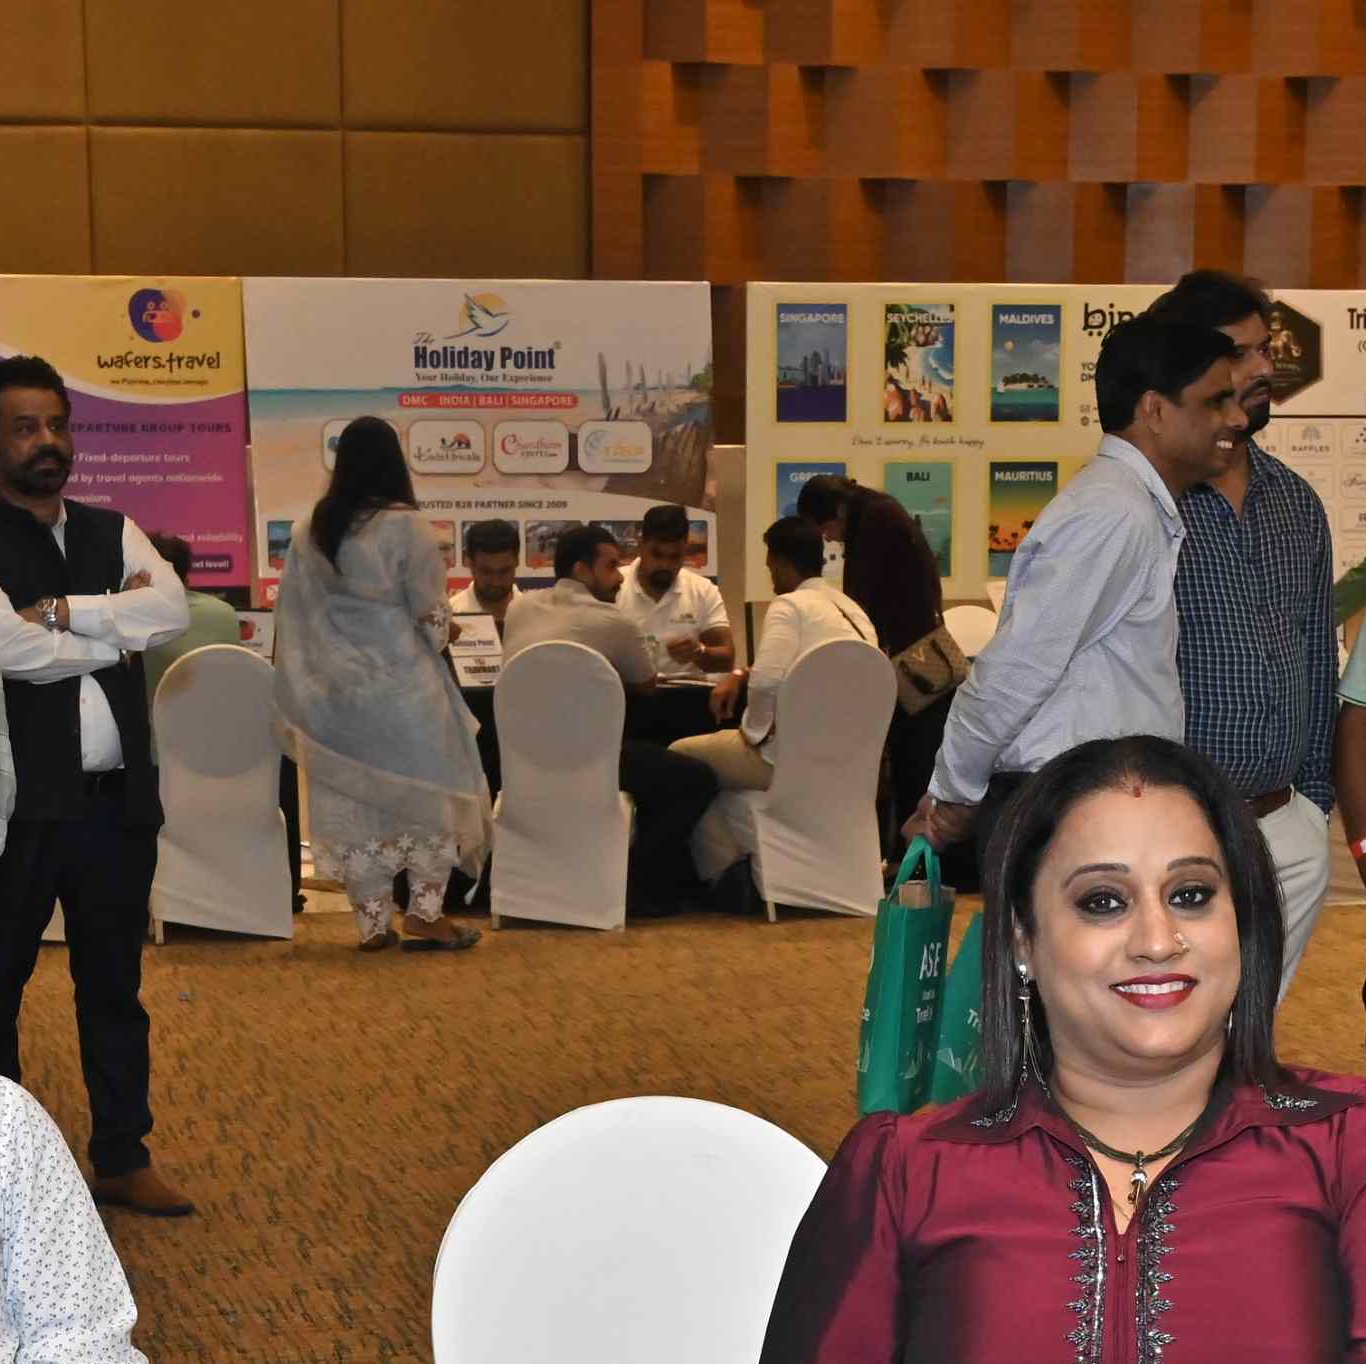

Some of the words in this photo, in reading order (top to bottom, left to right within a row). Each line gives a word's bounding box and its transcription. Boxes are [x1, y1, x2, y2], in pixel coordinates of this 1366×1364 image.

[779, 312, 845, 324] SINGAPORE
[999, 313, 1055, 325] MALDIVES
[96, 351, 221, 373] wafers.travel
[414, 346, 495, 371] Holiday
[500, 346, 555, 369] Point
[416, 373, 437, 383] Your
[481, 373, 499, 383] Our
[502, 373, 553, 384] Experience
[403, 395, 428, 406] DMC
[439, 395, 469, 406] INDIA
[479, 395, 503, 406] BALI
[512, 395, 573, 406] SINGAPORE
[70, 422, 137, 433] EPARTURE
[141, 422, 185, 433] GROUP
[190, 422, 232, 433] TOURS
[96, 473, 126, 482] travel
[906, 471, 931, 482] BALI
[994, 471, 1054, 482] MAURITIUS
[474, 500, 516, 510] PARTNER
[518, 500, 543, 510] SINCE
[918, 941, 942, 981] ASE
